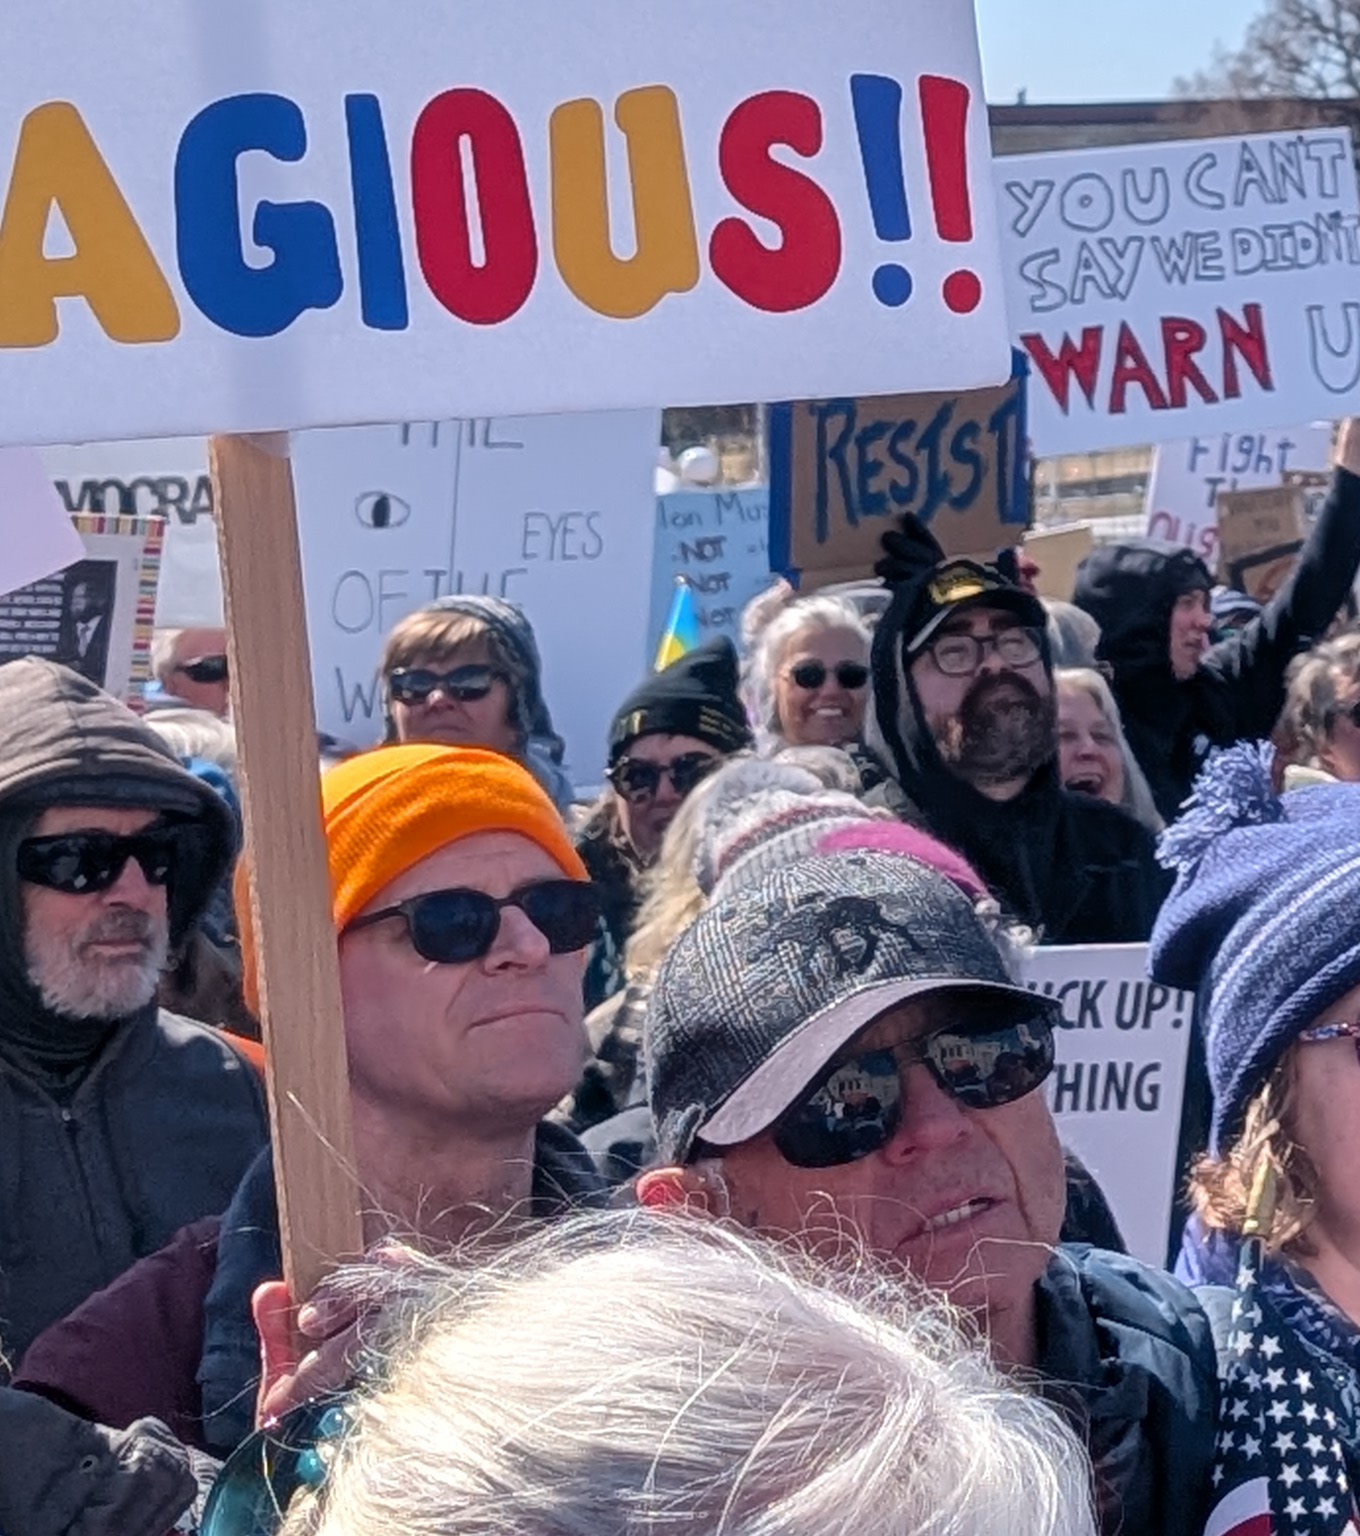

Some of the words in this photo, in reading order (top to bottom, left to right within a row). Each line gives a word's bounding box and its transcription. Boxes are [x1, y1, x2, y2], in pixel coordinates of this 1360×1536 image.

[1005, 170, 1171, 239] YOU
[1018, 235, 1145, 313] SAY
[1150, 230, 1226, 285] WE
[1018, 302, 1277, 416] WARN
[809, 396, 1024, 545] RESIST
[522, 509, 604, 561] EYES
[332, 569, 409, 635] OF
[1115, 979, 1185, 1031] UP!
[1050, 1060, 1162, 1114] HING
